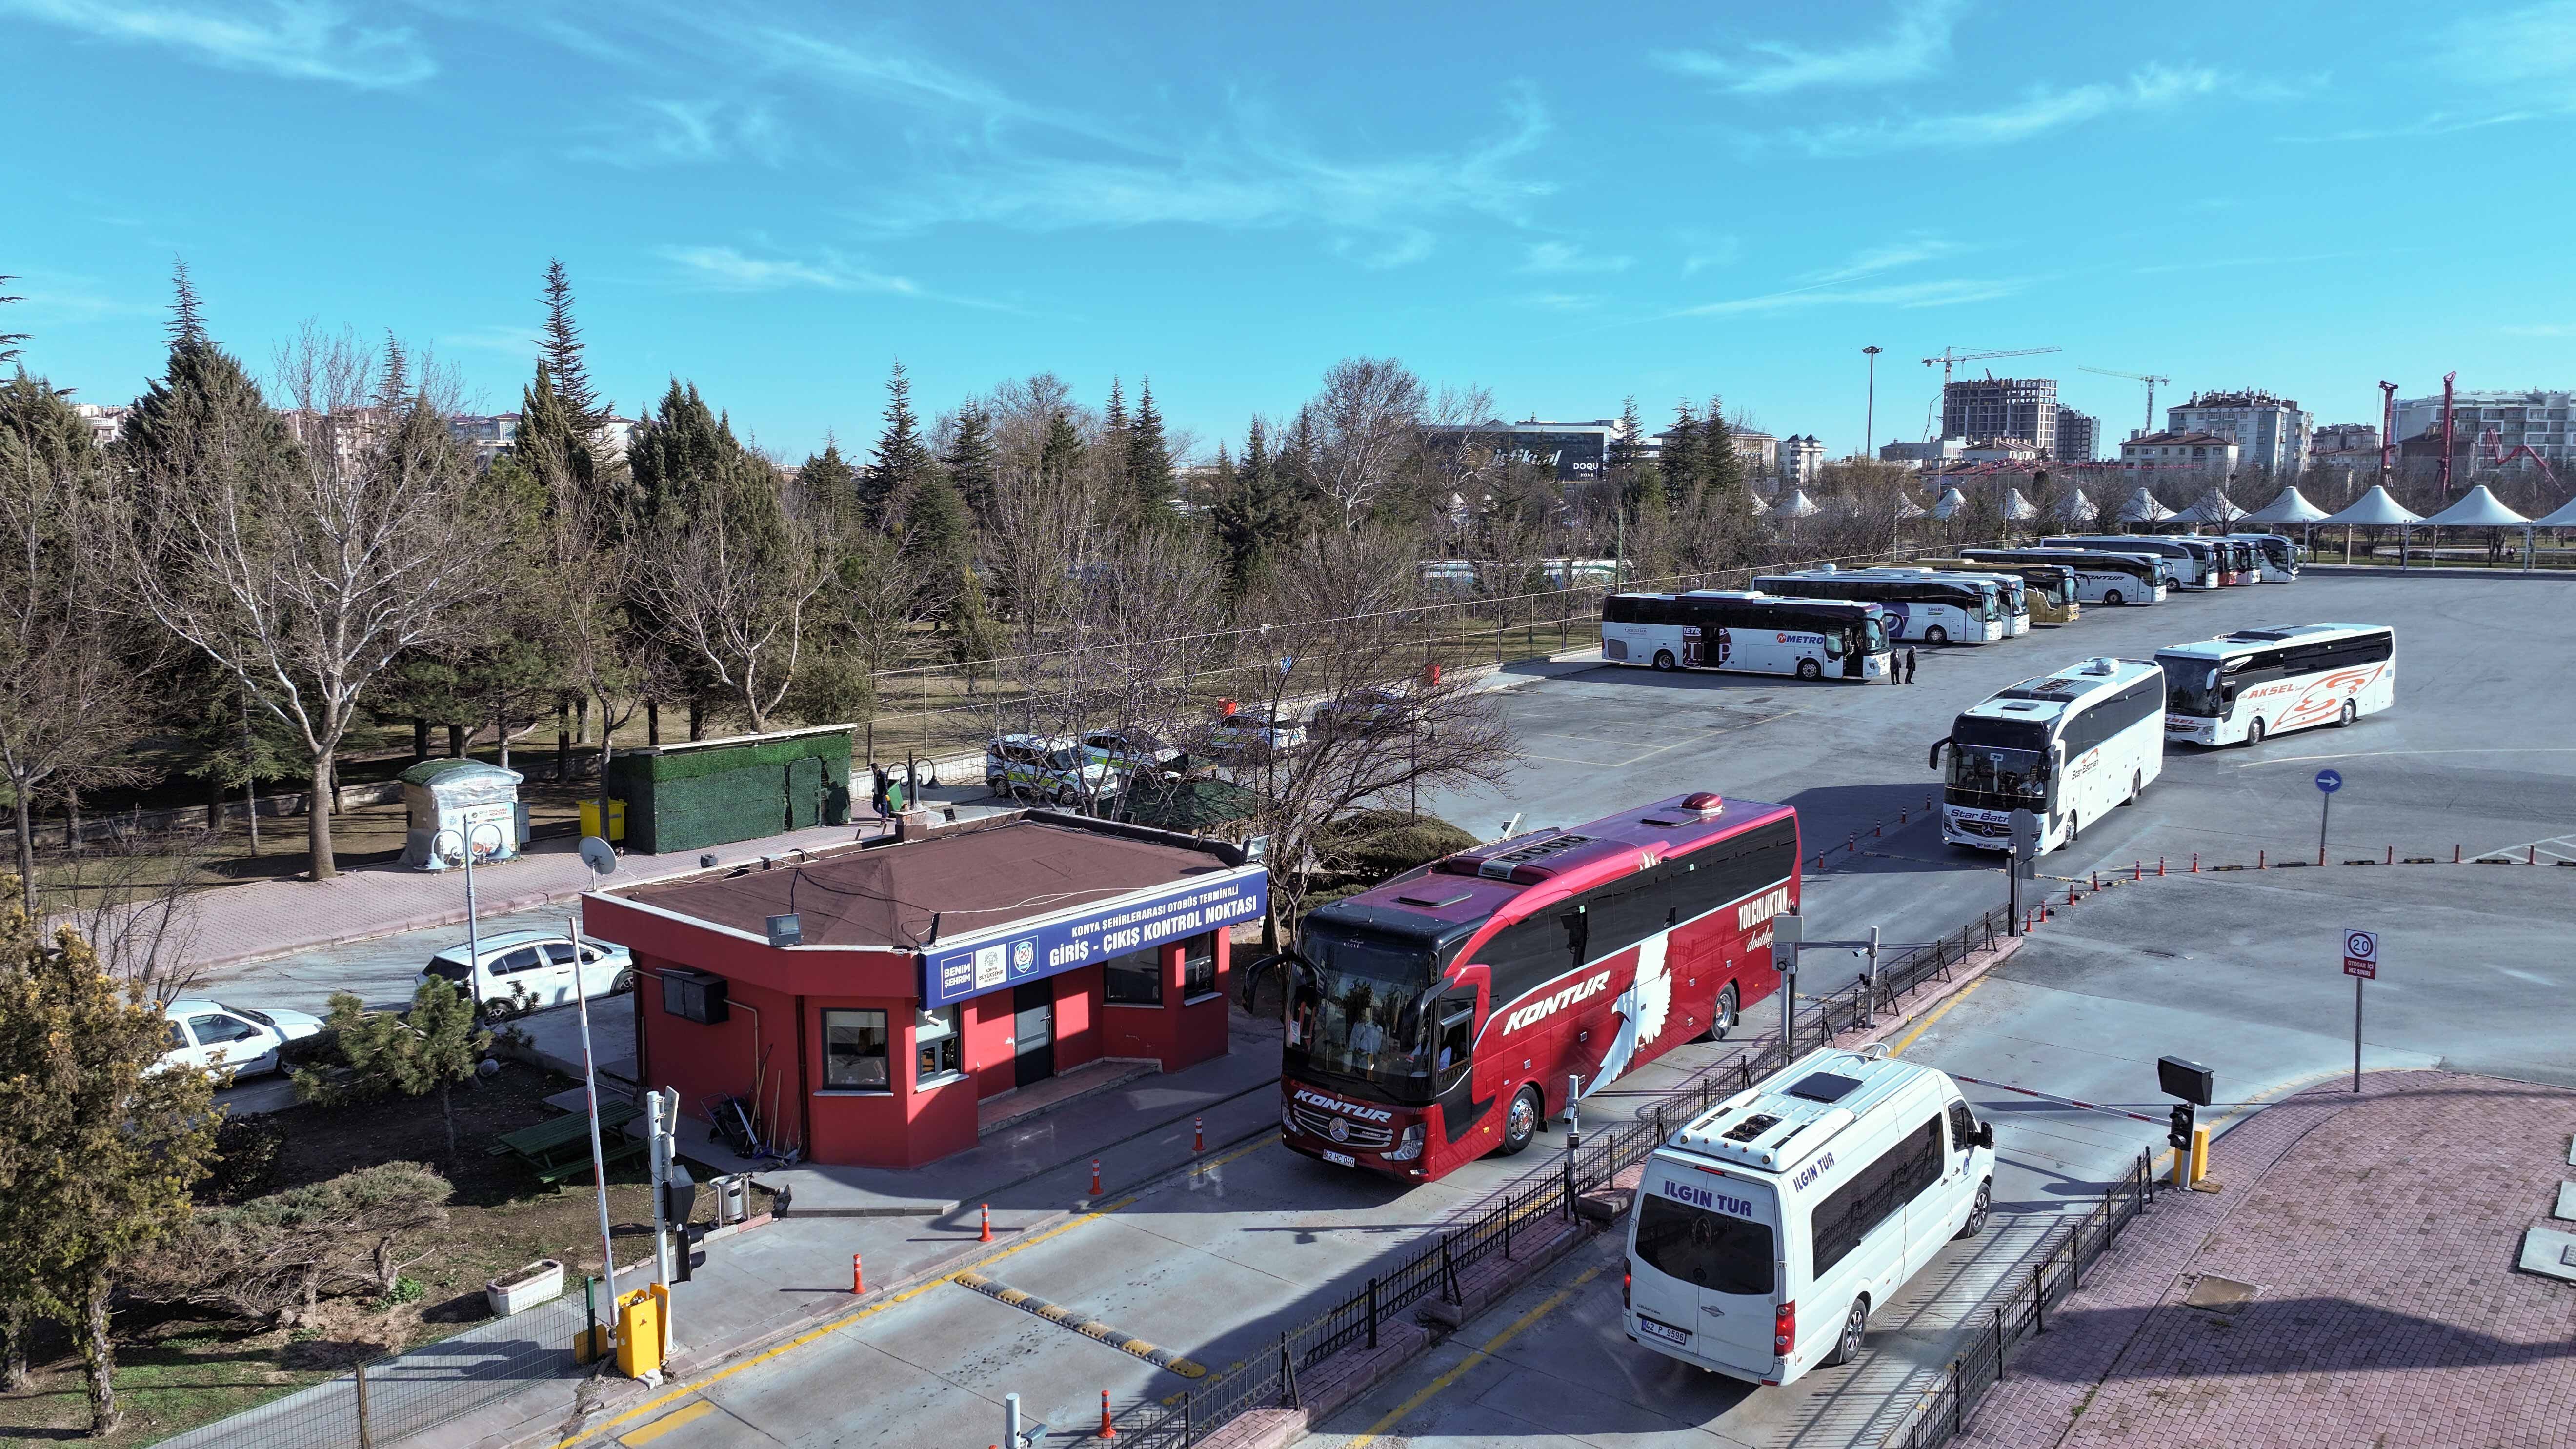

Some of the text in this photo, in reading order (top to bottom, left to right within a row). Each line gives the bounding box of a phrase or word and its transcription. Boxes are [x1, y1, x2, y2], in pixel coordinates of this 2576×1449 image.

[1573, 463, 1599, 471] DOQU
[1786, 635, 1824, 644] METRO
[2248, 684, 2294, 699] AKSEL
[1951, 809, 1978, 819] Star
[1072, 883, 1239, 937] KONYA ŞEHİRLERARASI OTOBÜS TERMİNALİ
[1738, 886, 1788, 931] YOLCULUKTAN
[1049, 939, 1089, 966] GİRİŞ
[1103, 928, 1140, 954] ÇIKIŞ
[1144, 911, 1201, 941] KONTROL
[1206, 895, 1256, 923] NOKTASI
[2353, 939, 2369, 952] 20
[944, 963, 970, 978] BENİM
[2348, 960, 2366, 968] OTOGAR
[944, 973, 970, 988] ŞEHRİM
[1503, 970, 1610, 1036] KONTUR
[1294, 1090, 1392, 1123] KONTUR
[1793, 1152, 1835, 1193] ILGIN TUR
[1664, 1180, 1752, 1217] ILGIN TUR
[1646, 1322, 1654, 1331] 42
[1667, 1329, 1684, 1341] 9596
